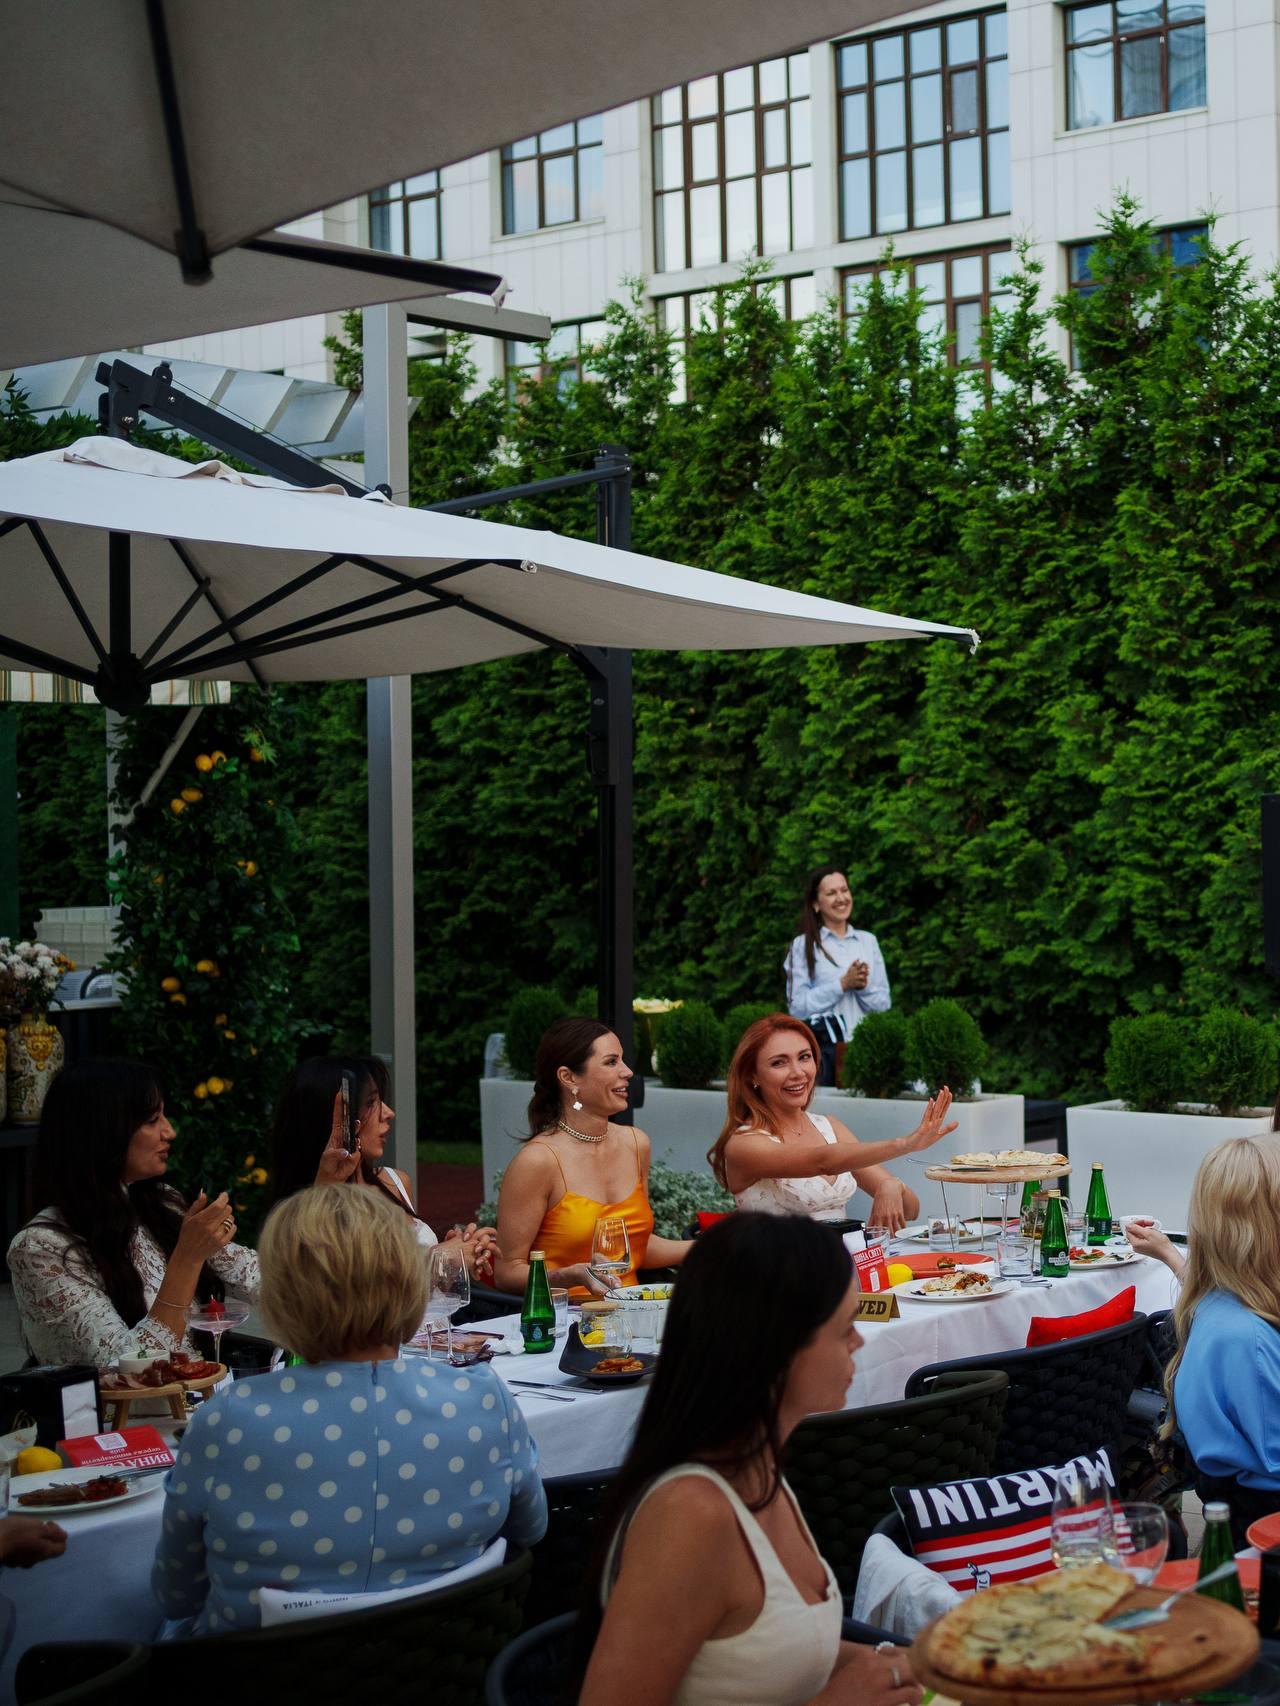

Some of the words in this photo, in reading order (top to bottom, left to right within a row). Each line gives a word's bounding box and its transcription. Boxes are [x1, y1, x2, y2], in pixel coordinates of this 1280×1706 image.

[127, 1453, 171, 1470] ВИНА
[908, 1447, 1117, 1529] MARTINI
[283, 1600, 312, 1610] ITALIA
